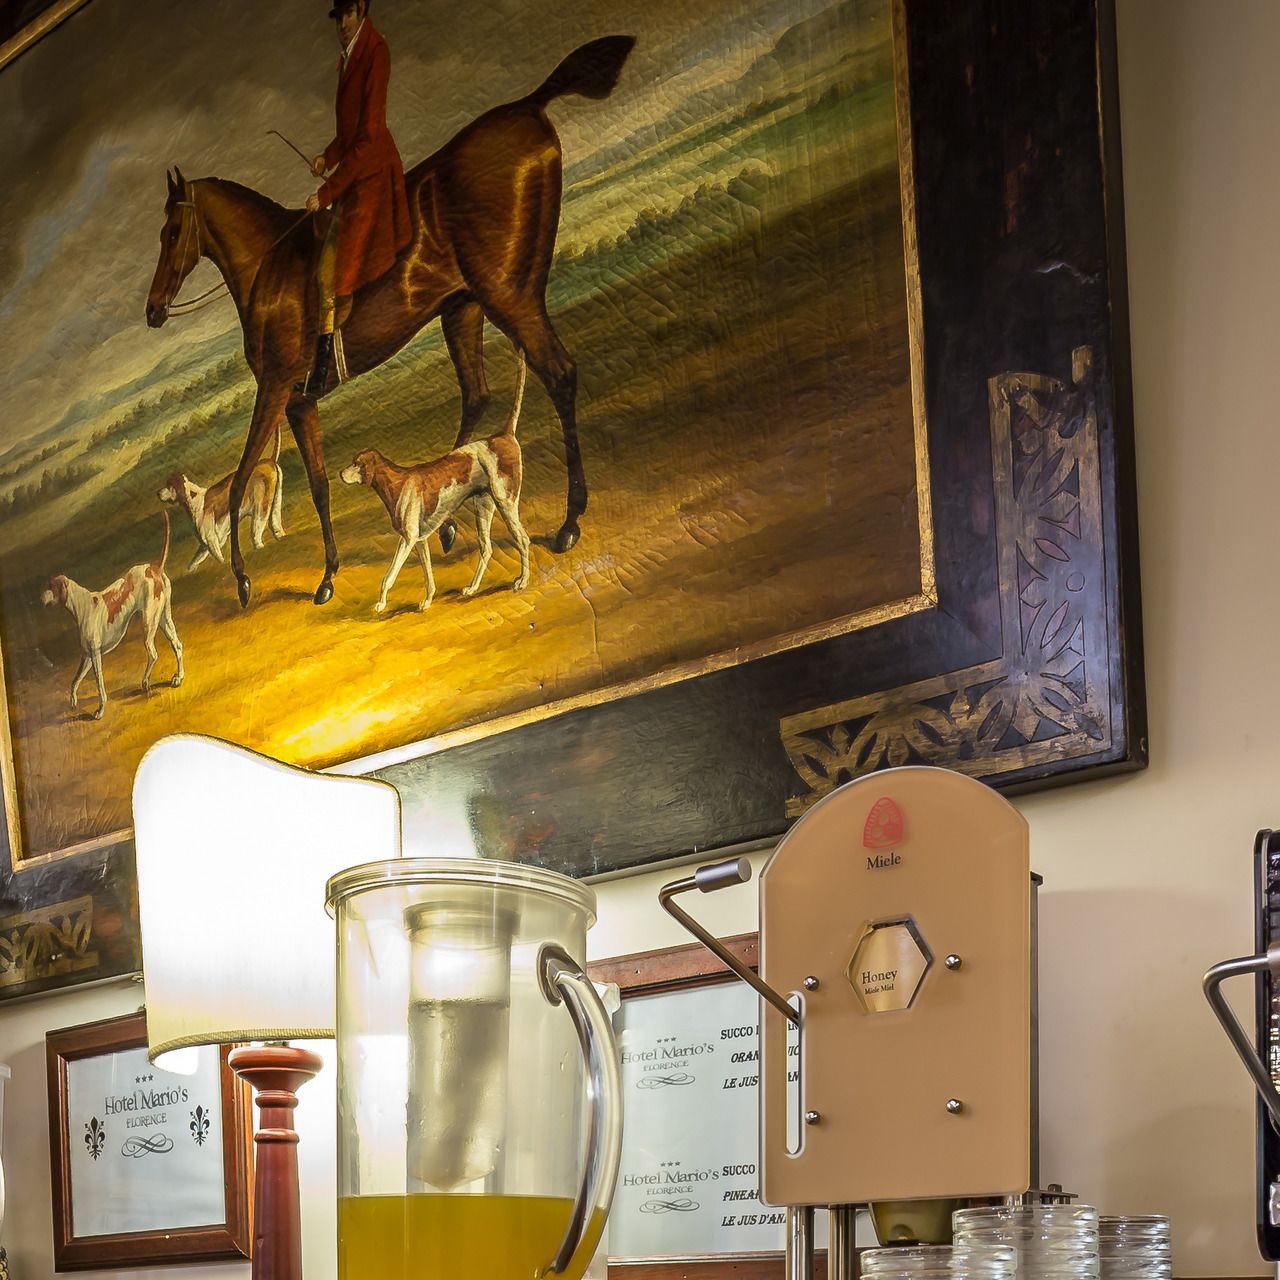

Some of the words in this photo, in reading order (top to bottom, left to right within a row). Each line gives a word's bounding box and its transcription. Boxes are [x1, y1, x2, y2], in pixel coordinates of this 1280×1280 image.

[866, 853, 902, 870] Miele
[862, 970, 898, 984] Honey
[864, 987, 880, 995] Miele
[880, 984, 894, 992] Miel
[720, 1026, 753, 1040] SUCCO
[621, 1048, 657, 1064] Hotel
[660, 1043, 715, 1059] Mario's
[731, 1050, 759, 1063] ORAN
[643, 1060, 689, 1071] FLORENCE
[722, 1078, 736, 1089] LE
[738, 1076, 759, 1088] JUS
[104, 1091, 138, 1115] Hotel
[138, 1085, 189, 1109] Mario's
[126, 1113, 168, 1128] FLORENCE
[722, 1164, 755, 1176] SUCCO
[623, 1172, 661, 1186] Hotel
[663, 1168, 720, 1184] Mario's
[646, 1185, 694, 1196] FLORENCE
[721, 1216, 736, 1227] LE
[737, 1214, 758, 1226] JUS
